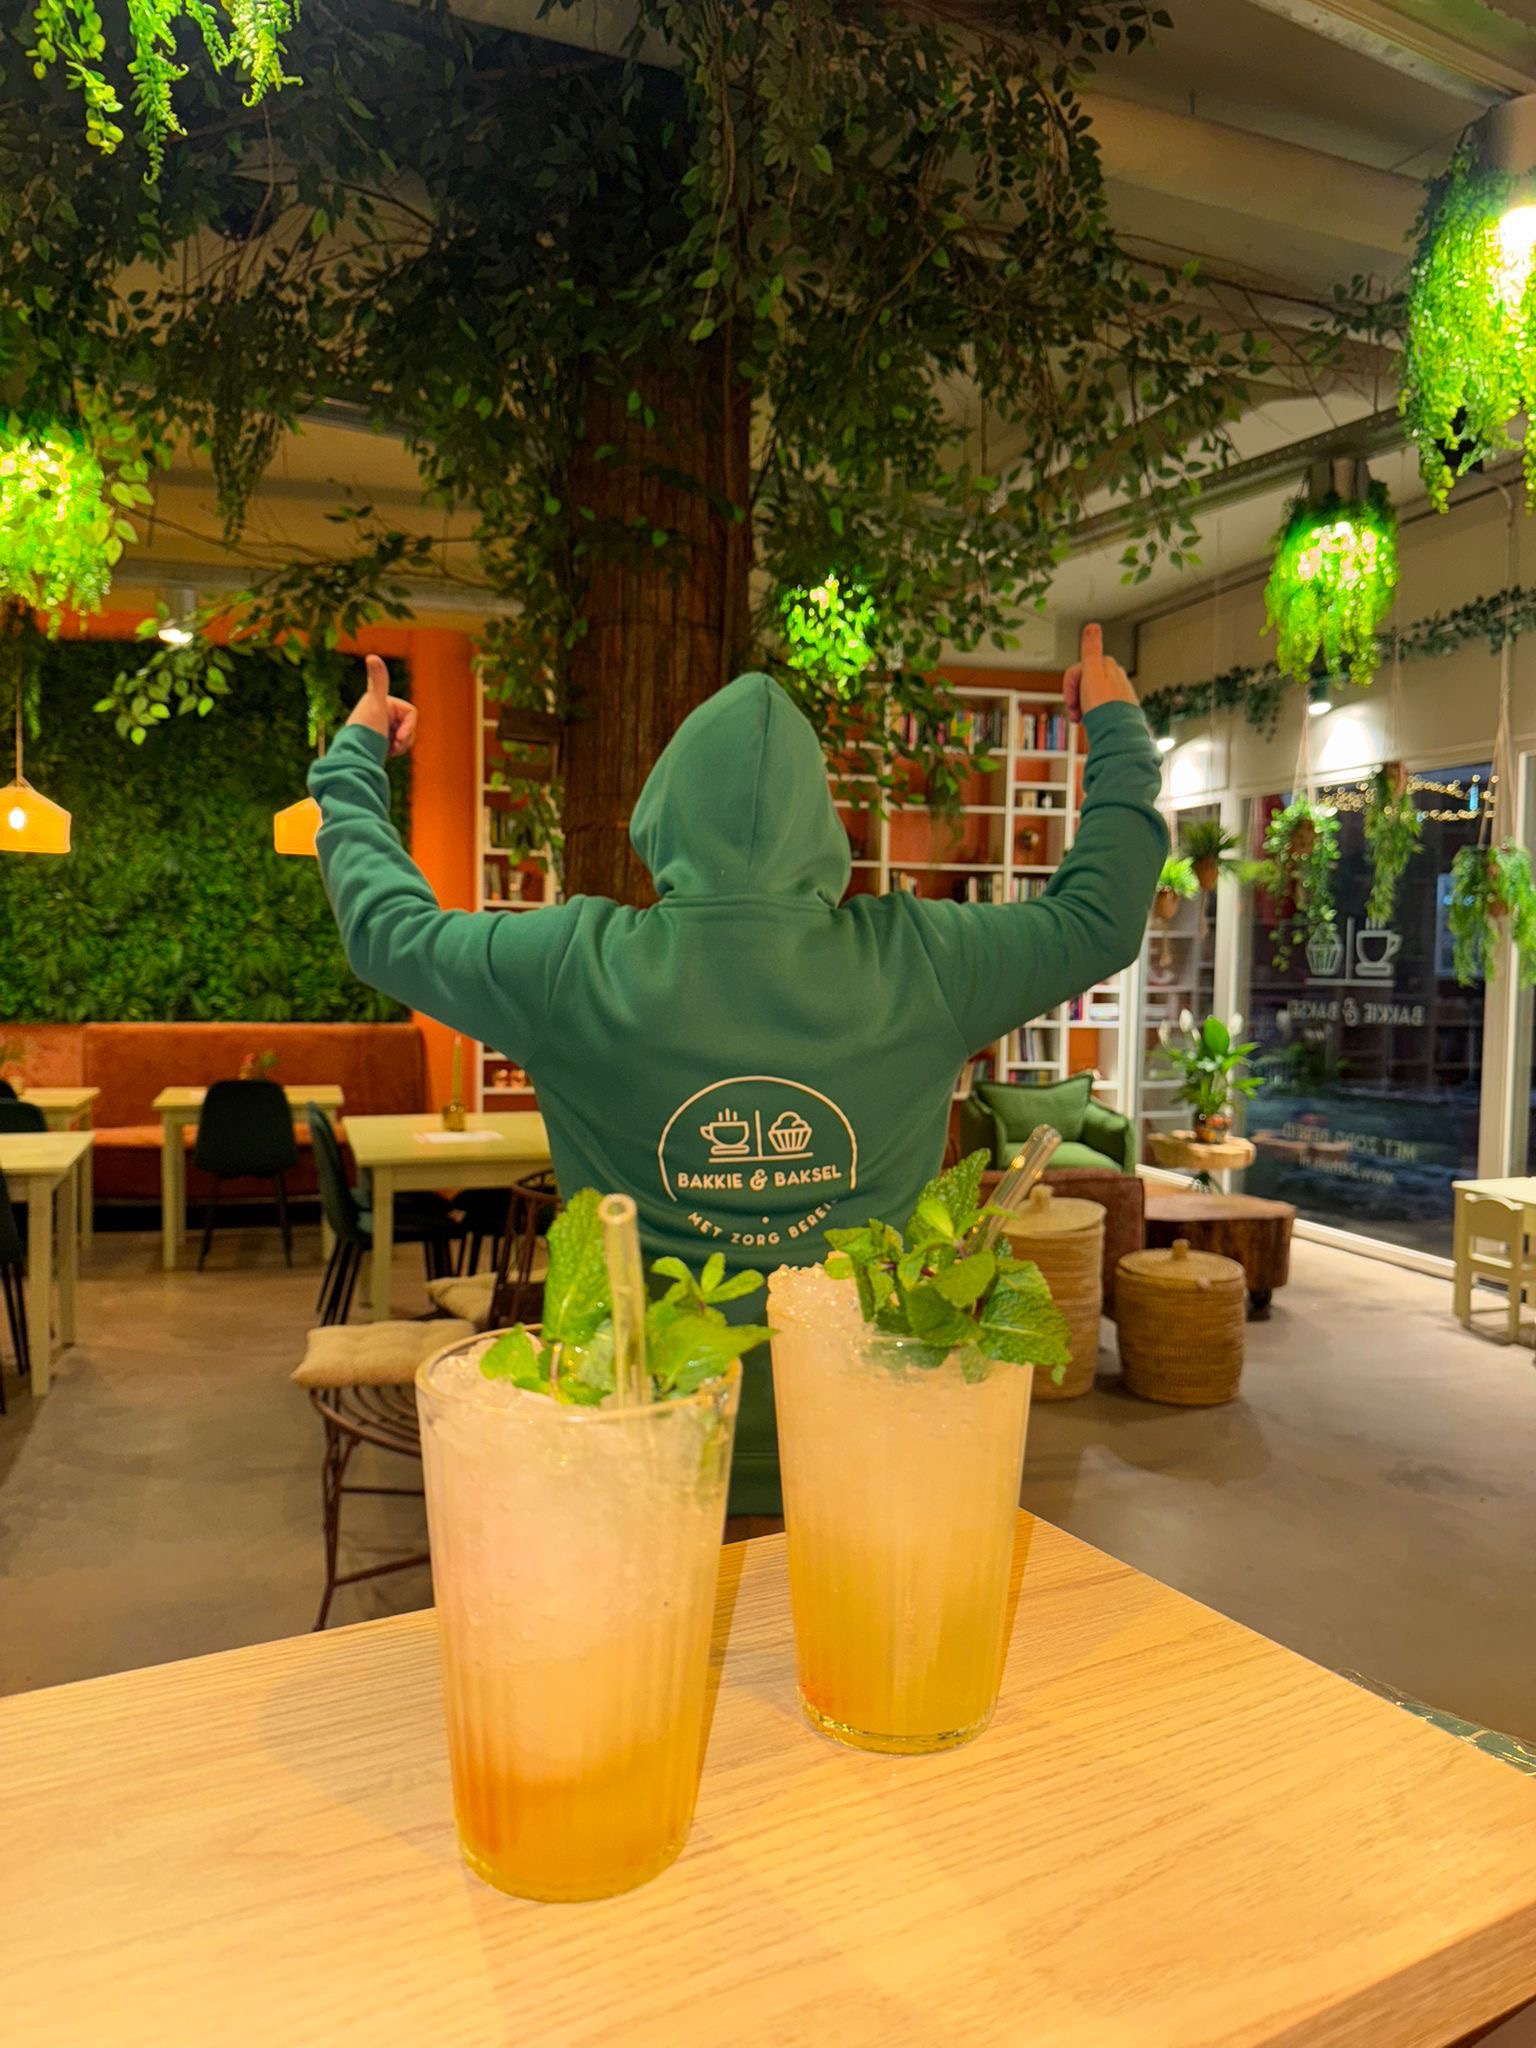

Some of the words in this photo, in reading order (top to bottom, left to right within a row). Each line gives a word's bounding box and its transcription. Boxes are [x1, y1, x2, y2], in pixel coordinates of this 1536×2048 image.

[677, 1172, 744, 1190] BAKKIE
[749, 1168, 768, 1191] &
[774, 1164, 842, 1187] BAKSEL
[687, 1211, 723, 1239] MET
[730, 1231, 781, 1246] ZORG
[788, 1199, 837, 1239] BEREI
